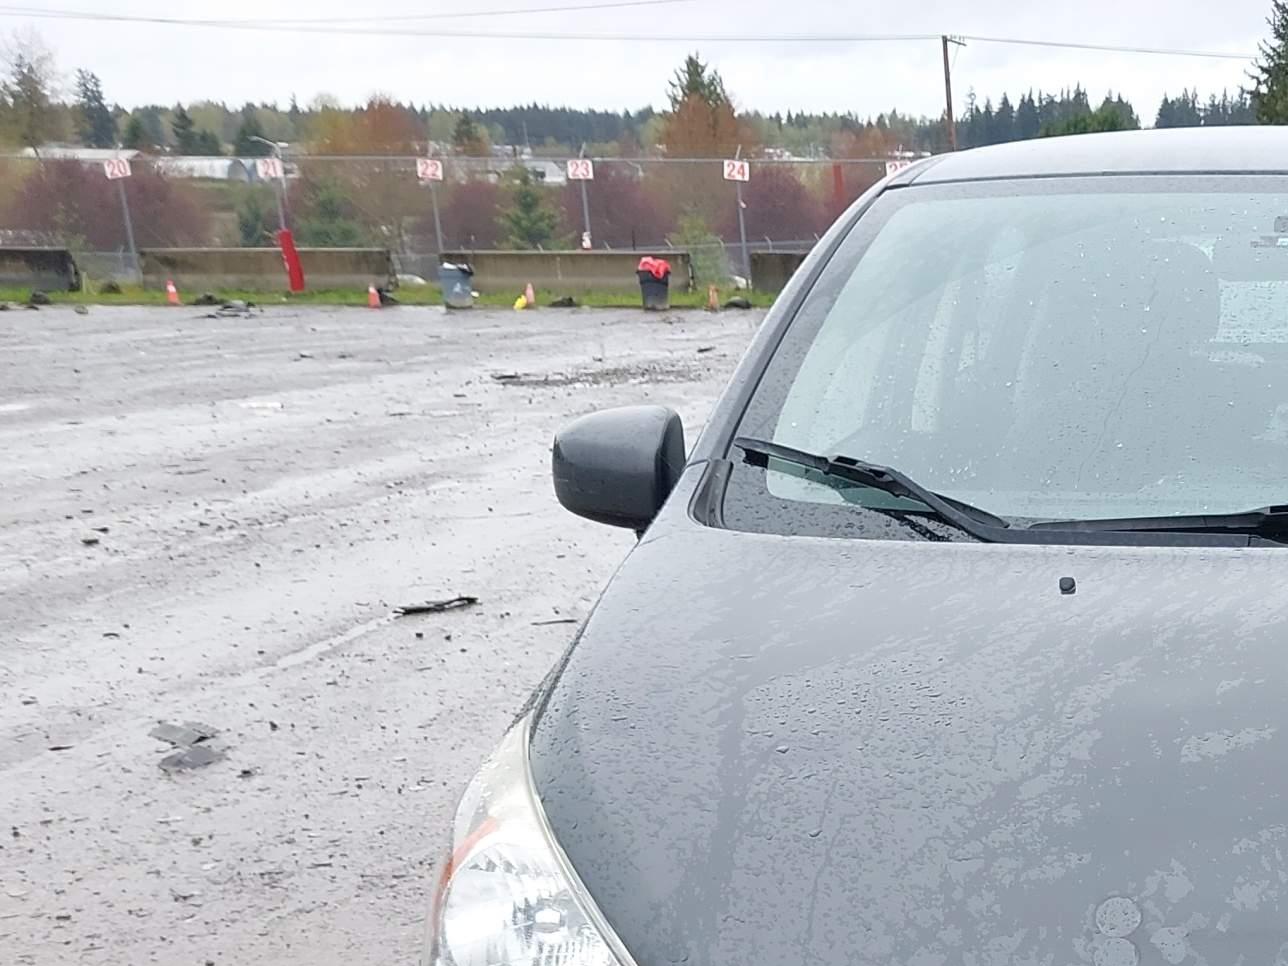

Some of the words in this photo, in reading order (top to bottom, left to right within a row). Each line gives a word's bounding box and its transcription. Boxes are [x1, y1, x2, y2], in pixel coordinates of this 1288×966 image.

[107, 160, 127, 176] 20
[262, 160, 278, 176] 21
[420, 161, 440, 177] 22
[571, 160, 591, 177] 23
[726, 163, 746, 179] 24
